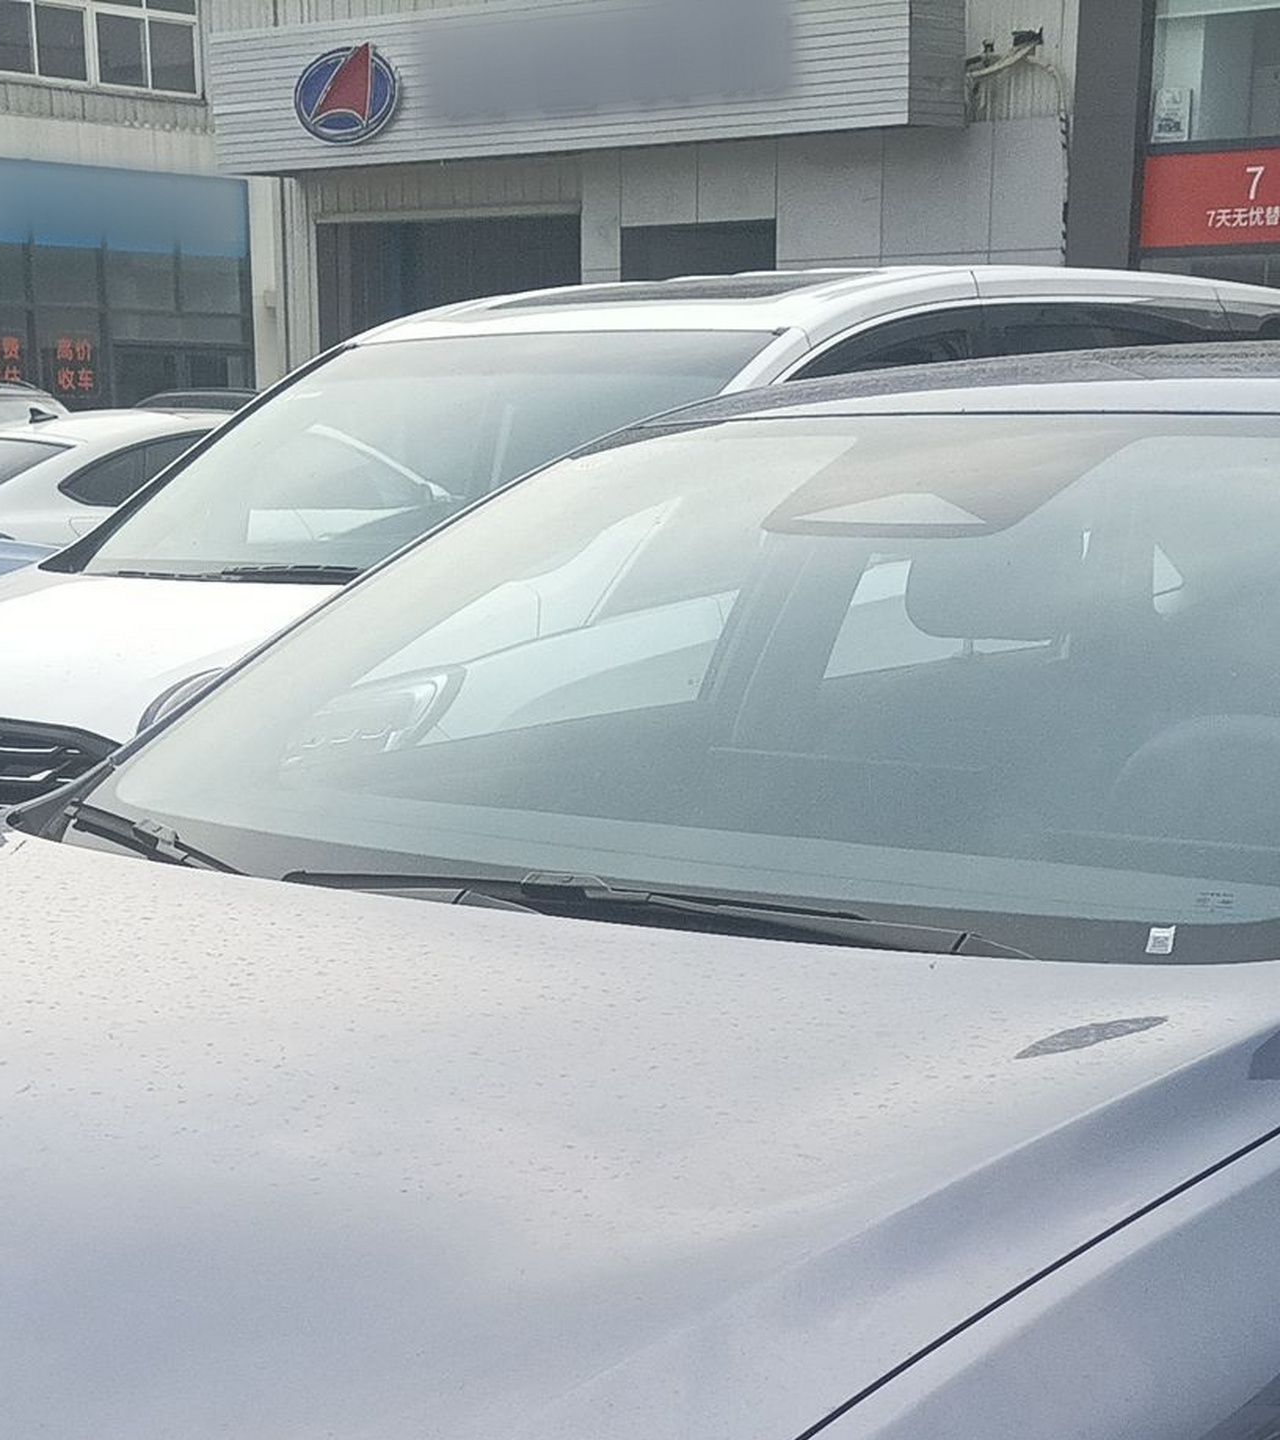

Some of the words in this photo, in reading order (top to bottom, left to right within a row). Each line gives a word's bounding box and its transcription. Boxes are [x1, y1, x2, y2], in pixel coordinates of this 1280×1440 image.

[1246, 165, 1265, 200] 7
[57, 338, 92, 361] 高价
[58, 367, 94, 391] 收车
